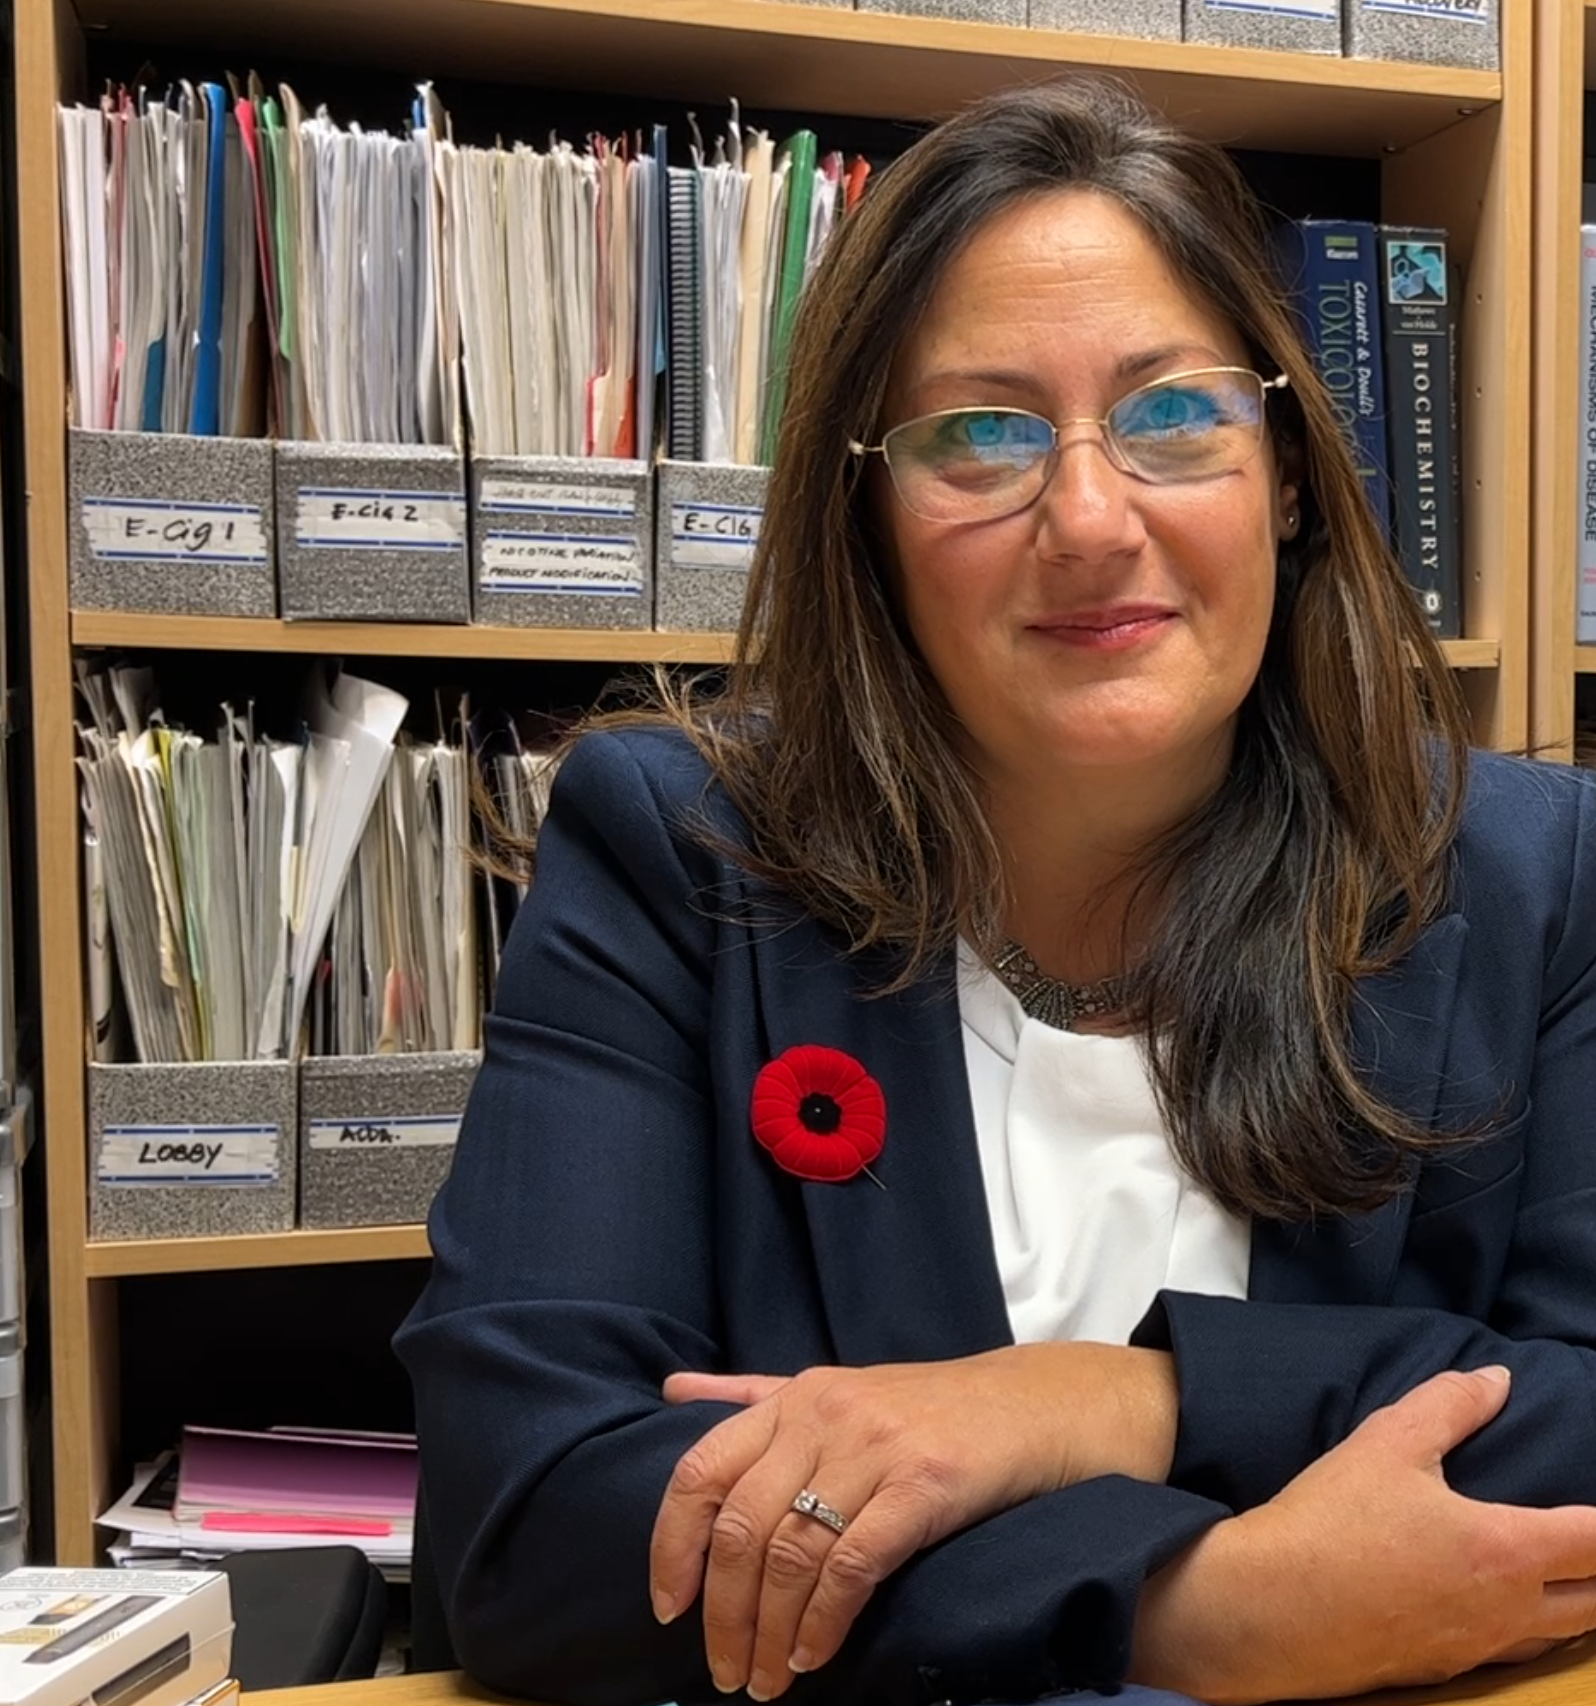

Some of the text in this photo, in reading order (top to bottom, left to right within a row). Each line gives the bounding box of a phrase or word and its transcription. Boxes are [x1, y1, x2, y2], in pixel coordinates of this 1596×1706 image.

[1357, 348, 1370, 362] &
[1411, 341, 1439, 570] BIOCHEMISTRY
[404, 505, 419, 521] 2
[224, 520, 235, 541] 1
[138, 1143, 222, 1169] LOBBY
